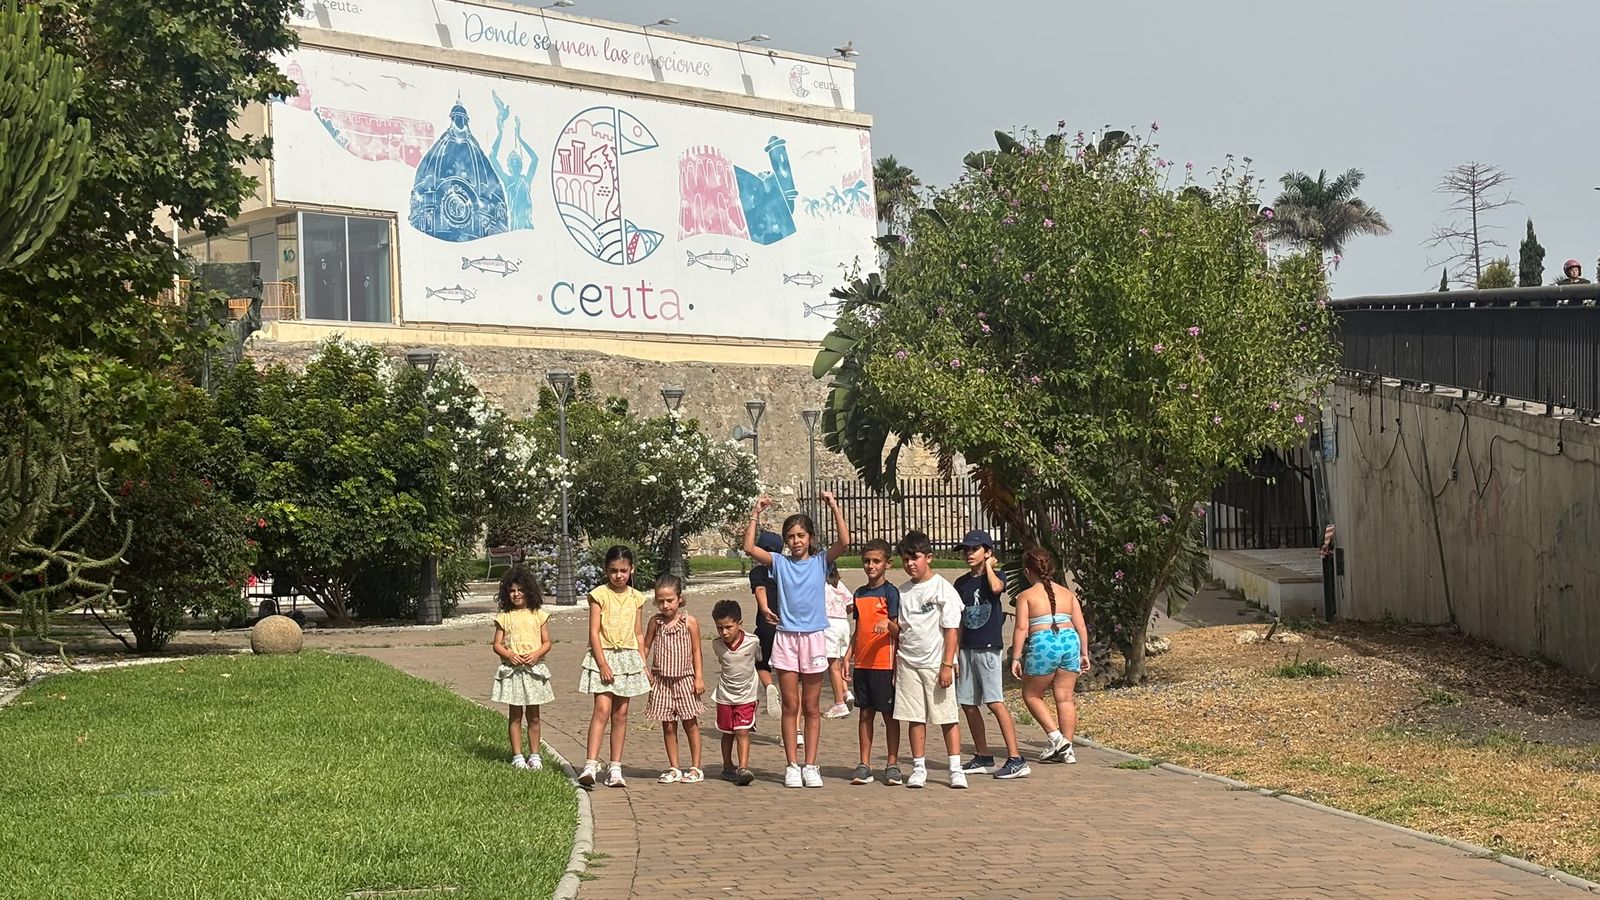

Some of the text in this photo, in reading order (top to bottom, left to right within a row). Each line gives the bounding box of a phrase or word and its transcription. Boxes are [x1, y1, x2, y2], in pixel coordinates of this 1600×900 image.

[463, 12, 712, 77] Donde se unen las emociones
